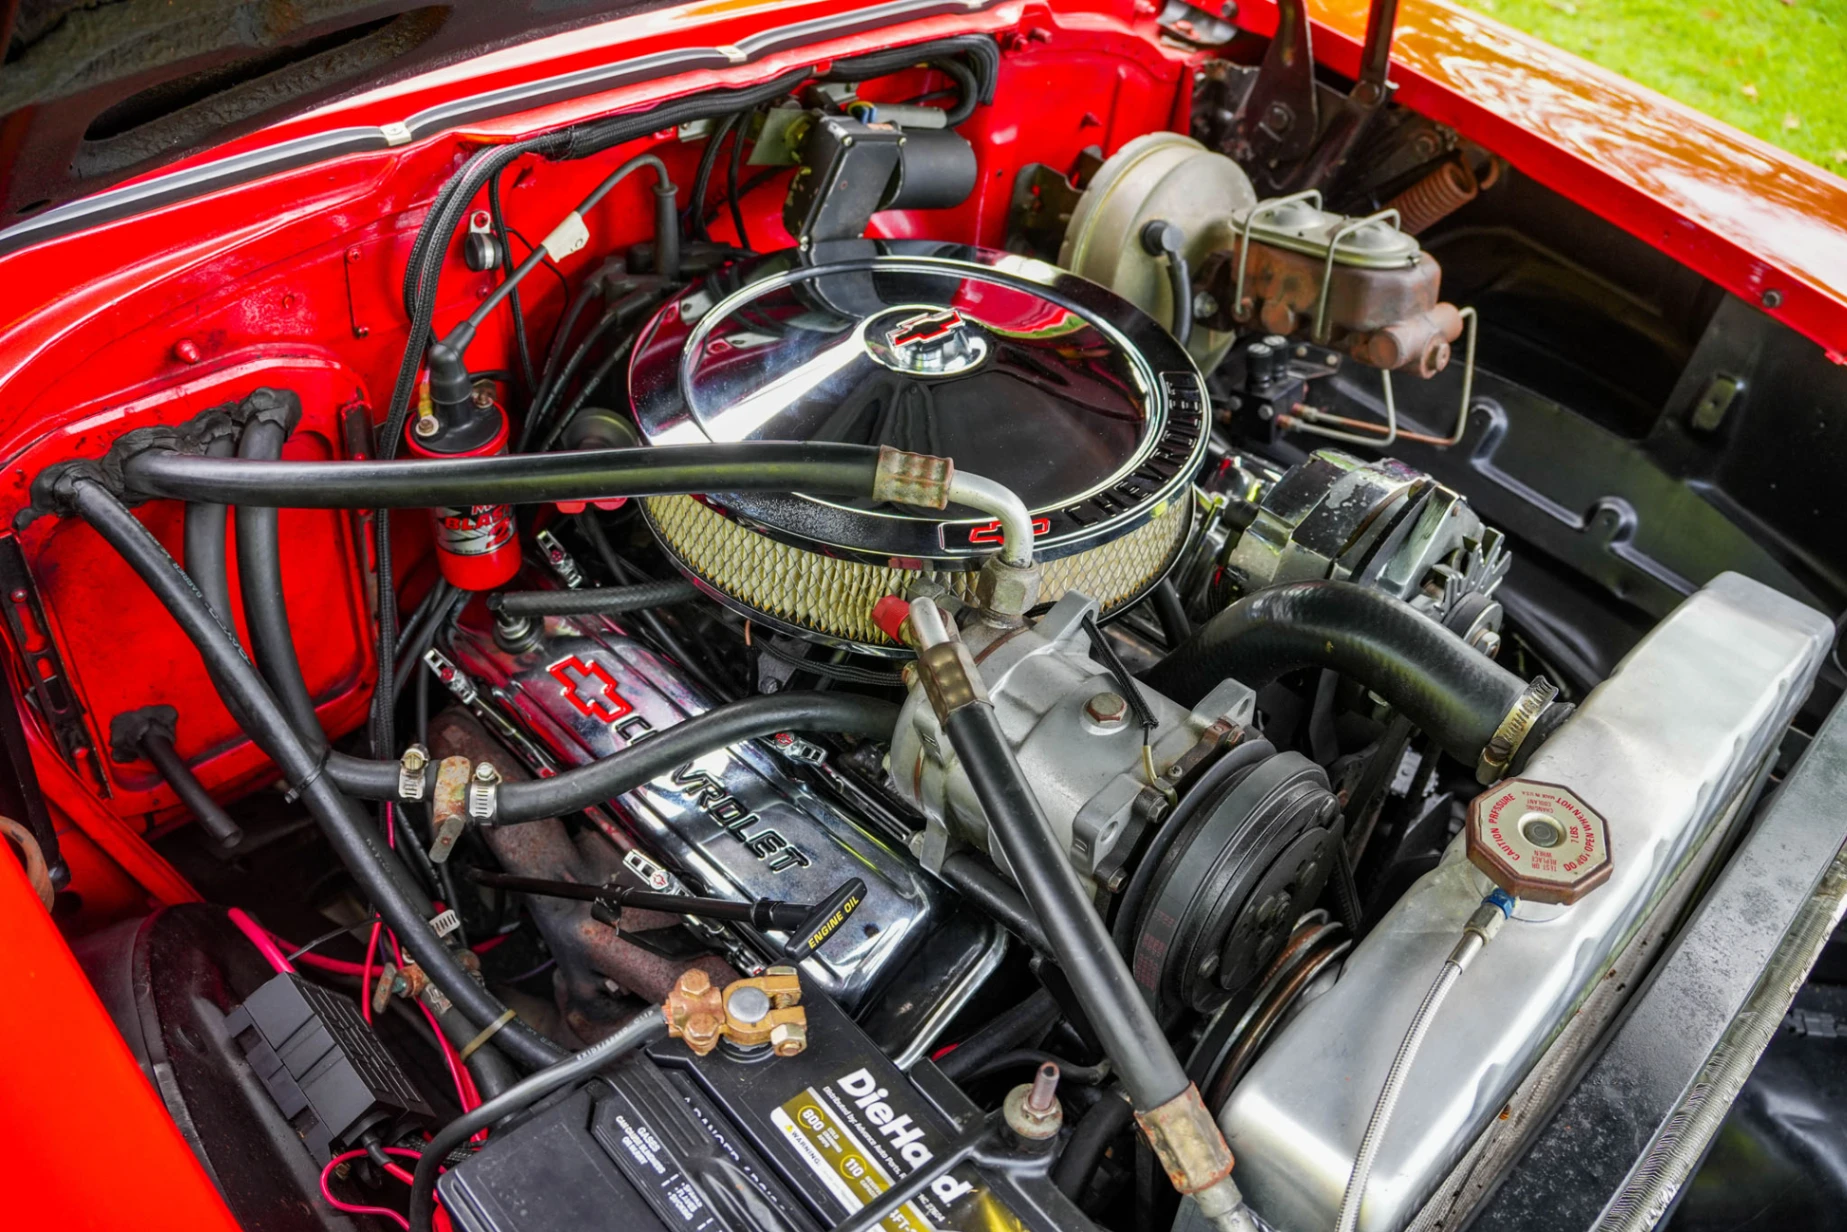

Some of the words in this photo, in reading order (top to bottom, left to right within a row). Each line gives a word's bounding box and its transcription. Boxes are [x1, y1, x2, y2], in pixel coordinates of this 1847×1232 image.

[1061, 381, 1202, 528] CHEVROLET
[613, 715, 812, 875] CVROLET
[1556, 797, 1575, 812] HOT
[1526, 805, 1554, 813] CHANGING
[1573, 809, 1592, 833] WHEN
[1570, 826, 1579, 839] LBS
[1584, 832, 1595, 852] OPEN
[1490, 828, 1521, 861] CAUTION
[1534, 850, 1552, 858] WHEN
[1532, 856, 1557, 865] REPLACE
[1542, 863, 1557, 872] TEST
[1563, 863, 1578, 872] DO
[808, 911, 844, 949] ENGINE
[844, 895, 860, 914] OIL
[634, 1010, 654, 1024] CLIP
[801, 1107, 825, 1132] 800
[821, 1084, 851, 1117] Distributed
[845, 1112, 858, 1125] by:
[854, 1120, 877, 1146] Advance
[873, 1142, 888, 1159] Auto
[637, 1126, 661, 1153] GASES
[837, 1067, 973, 1205] DieHad
[844, 1157, 865, 1179] 110
[916, 1192, 929, 1205] NC
